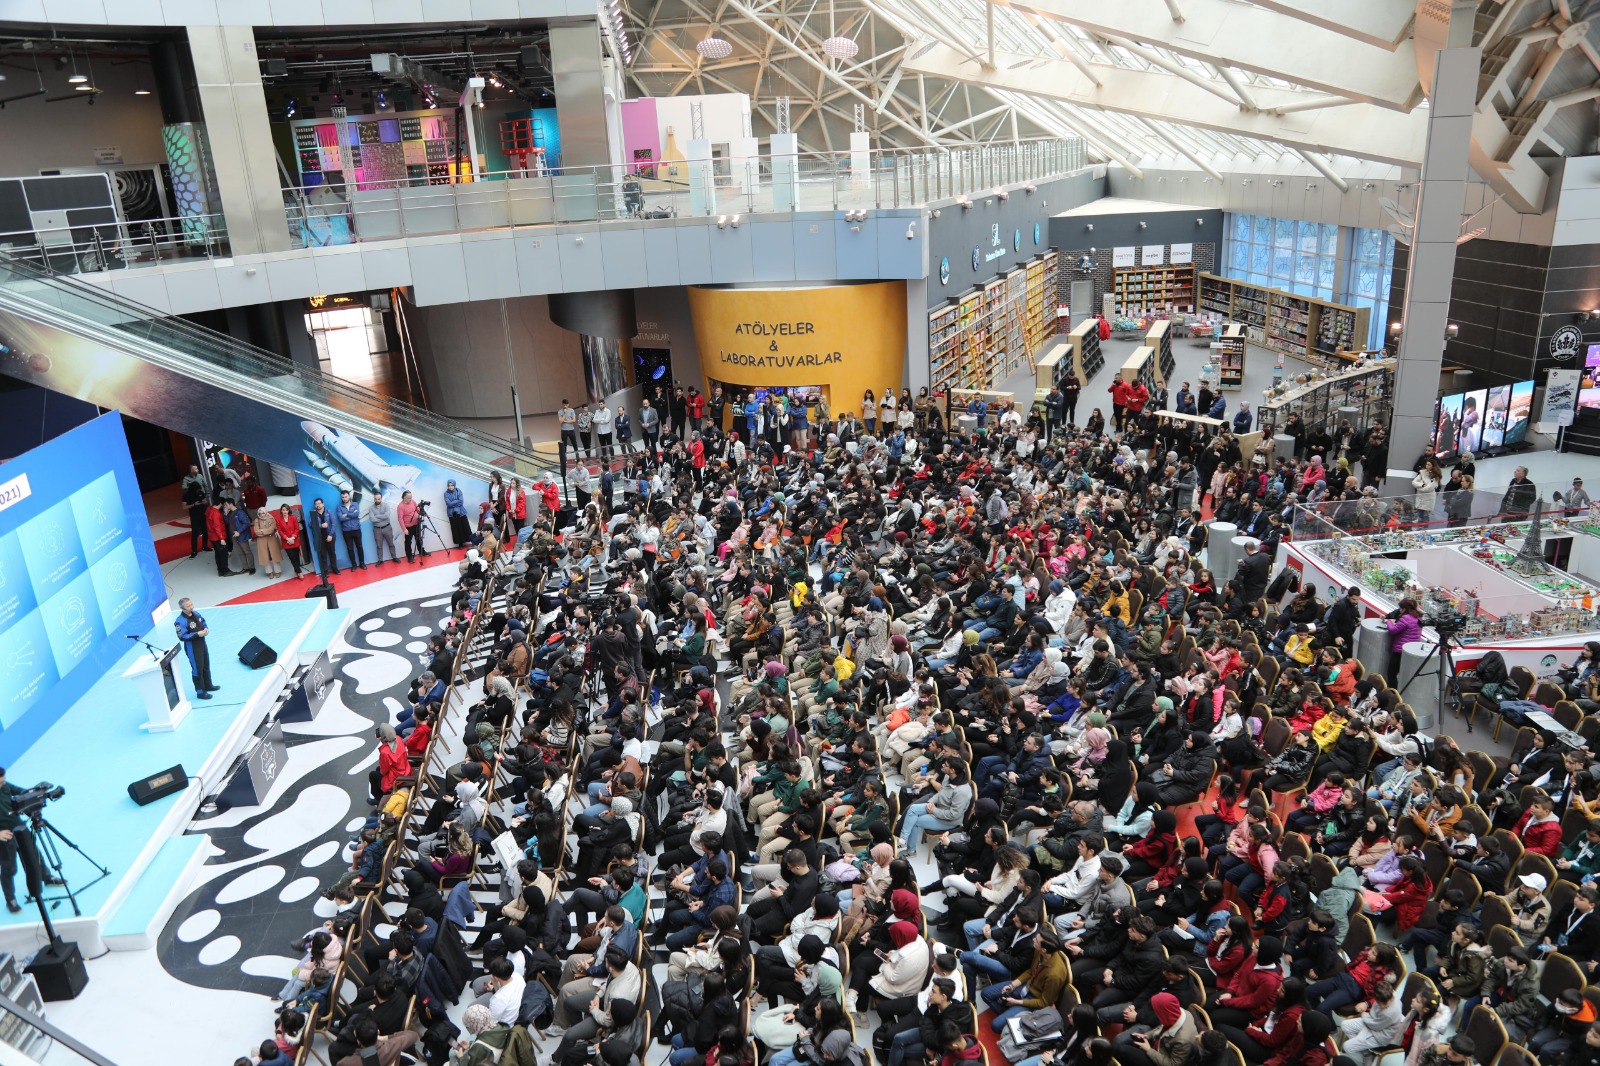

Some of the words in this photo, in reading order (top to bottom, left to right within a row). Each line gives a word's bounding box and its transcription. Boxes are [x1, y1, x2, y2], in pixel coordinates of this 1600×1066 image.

[735, 321, 815, 336] ATÖLYELER
[769, 340, 778, 352] &
[720, 351, 842, 368] LABORATUVARLAR
